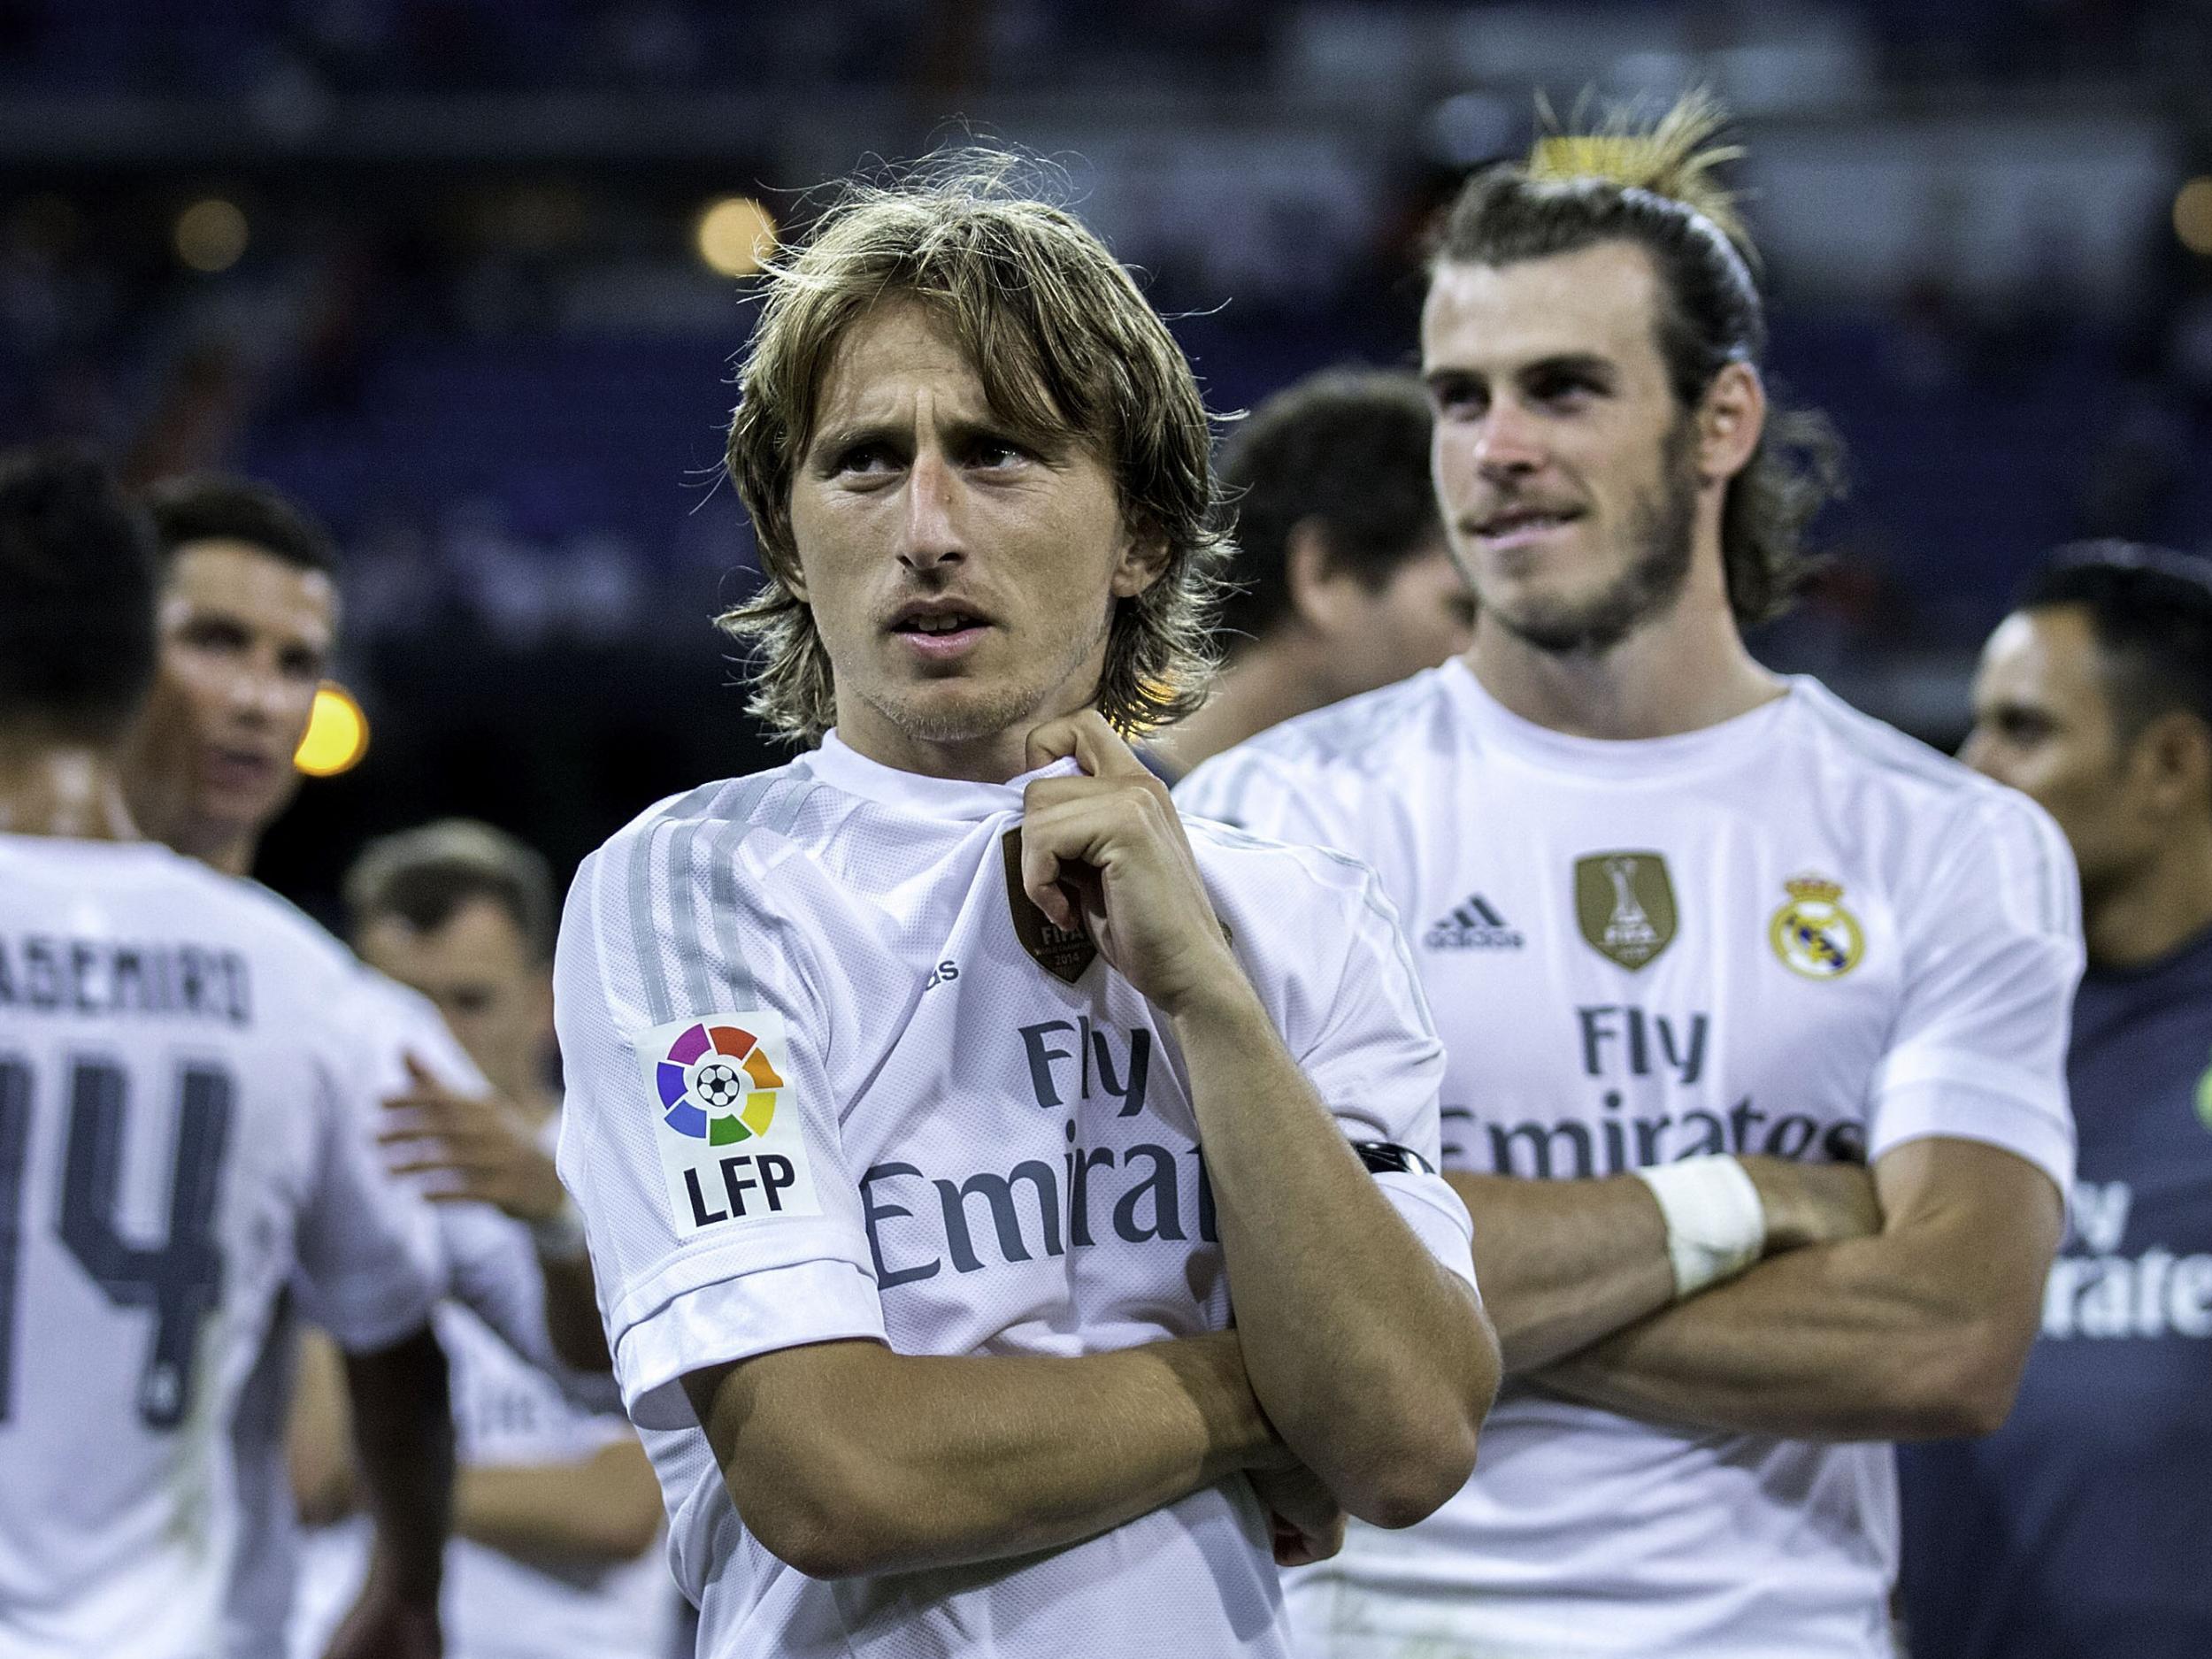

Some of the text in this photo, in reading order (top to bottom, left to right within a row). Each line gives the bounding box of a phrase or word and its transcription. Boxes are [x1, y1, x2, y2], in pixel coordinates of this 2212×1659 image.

[1018, 1016, 1150, 1118] Fly
[1577, 1005, 1709, 1084] Fly
[683, 1154, 795, 1227] LFP
